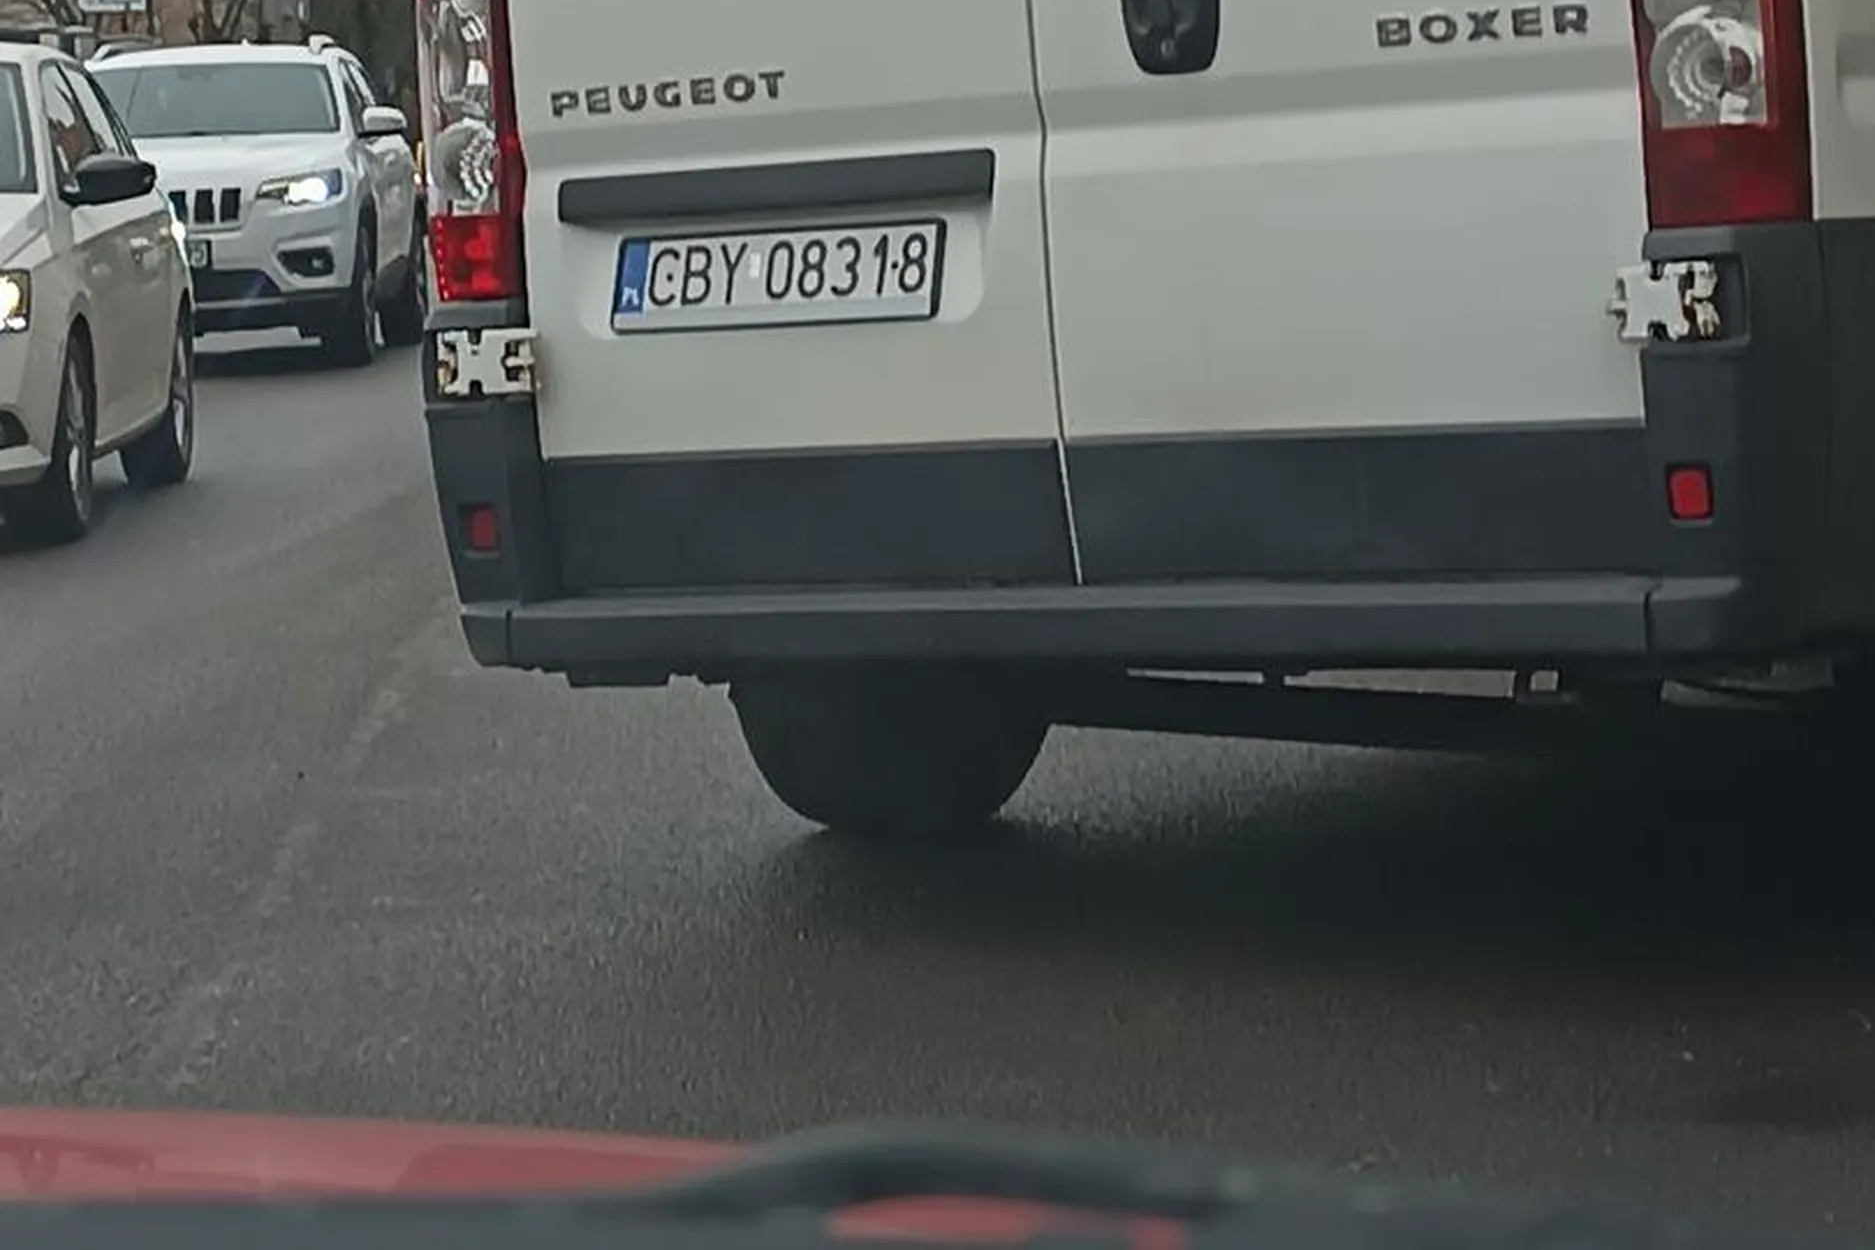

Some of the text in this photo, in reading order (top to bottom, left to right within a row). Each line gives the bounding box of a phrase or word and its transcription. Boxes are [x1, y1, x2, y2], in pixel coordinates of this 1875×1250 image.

[1376, 4, 1589, 47] BOXER
[550, 70, 785, 118] PEUGEOT
[649, 233, 928, 306] CBY 08318
